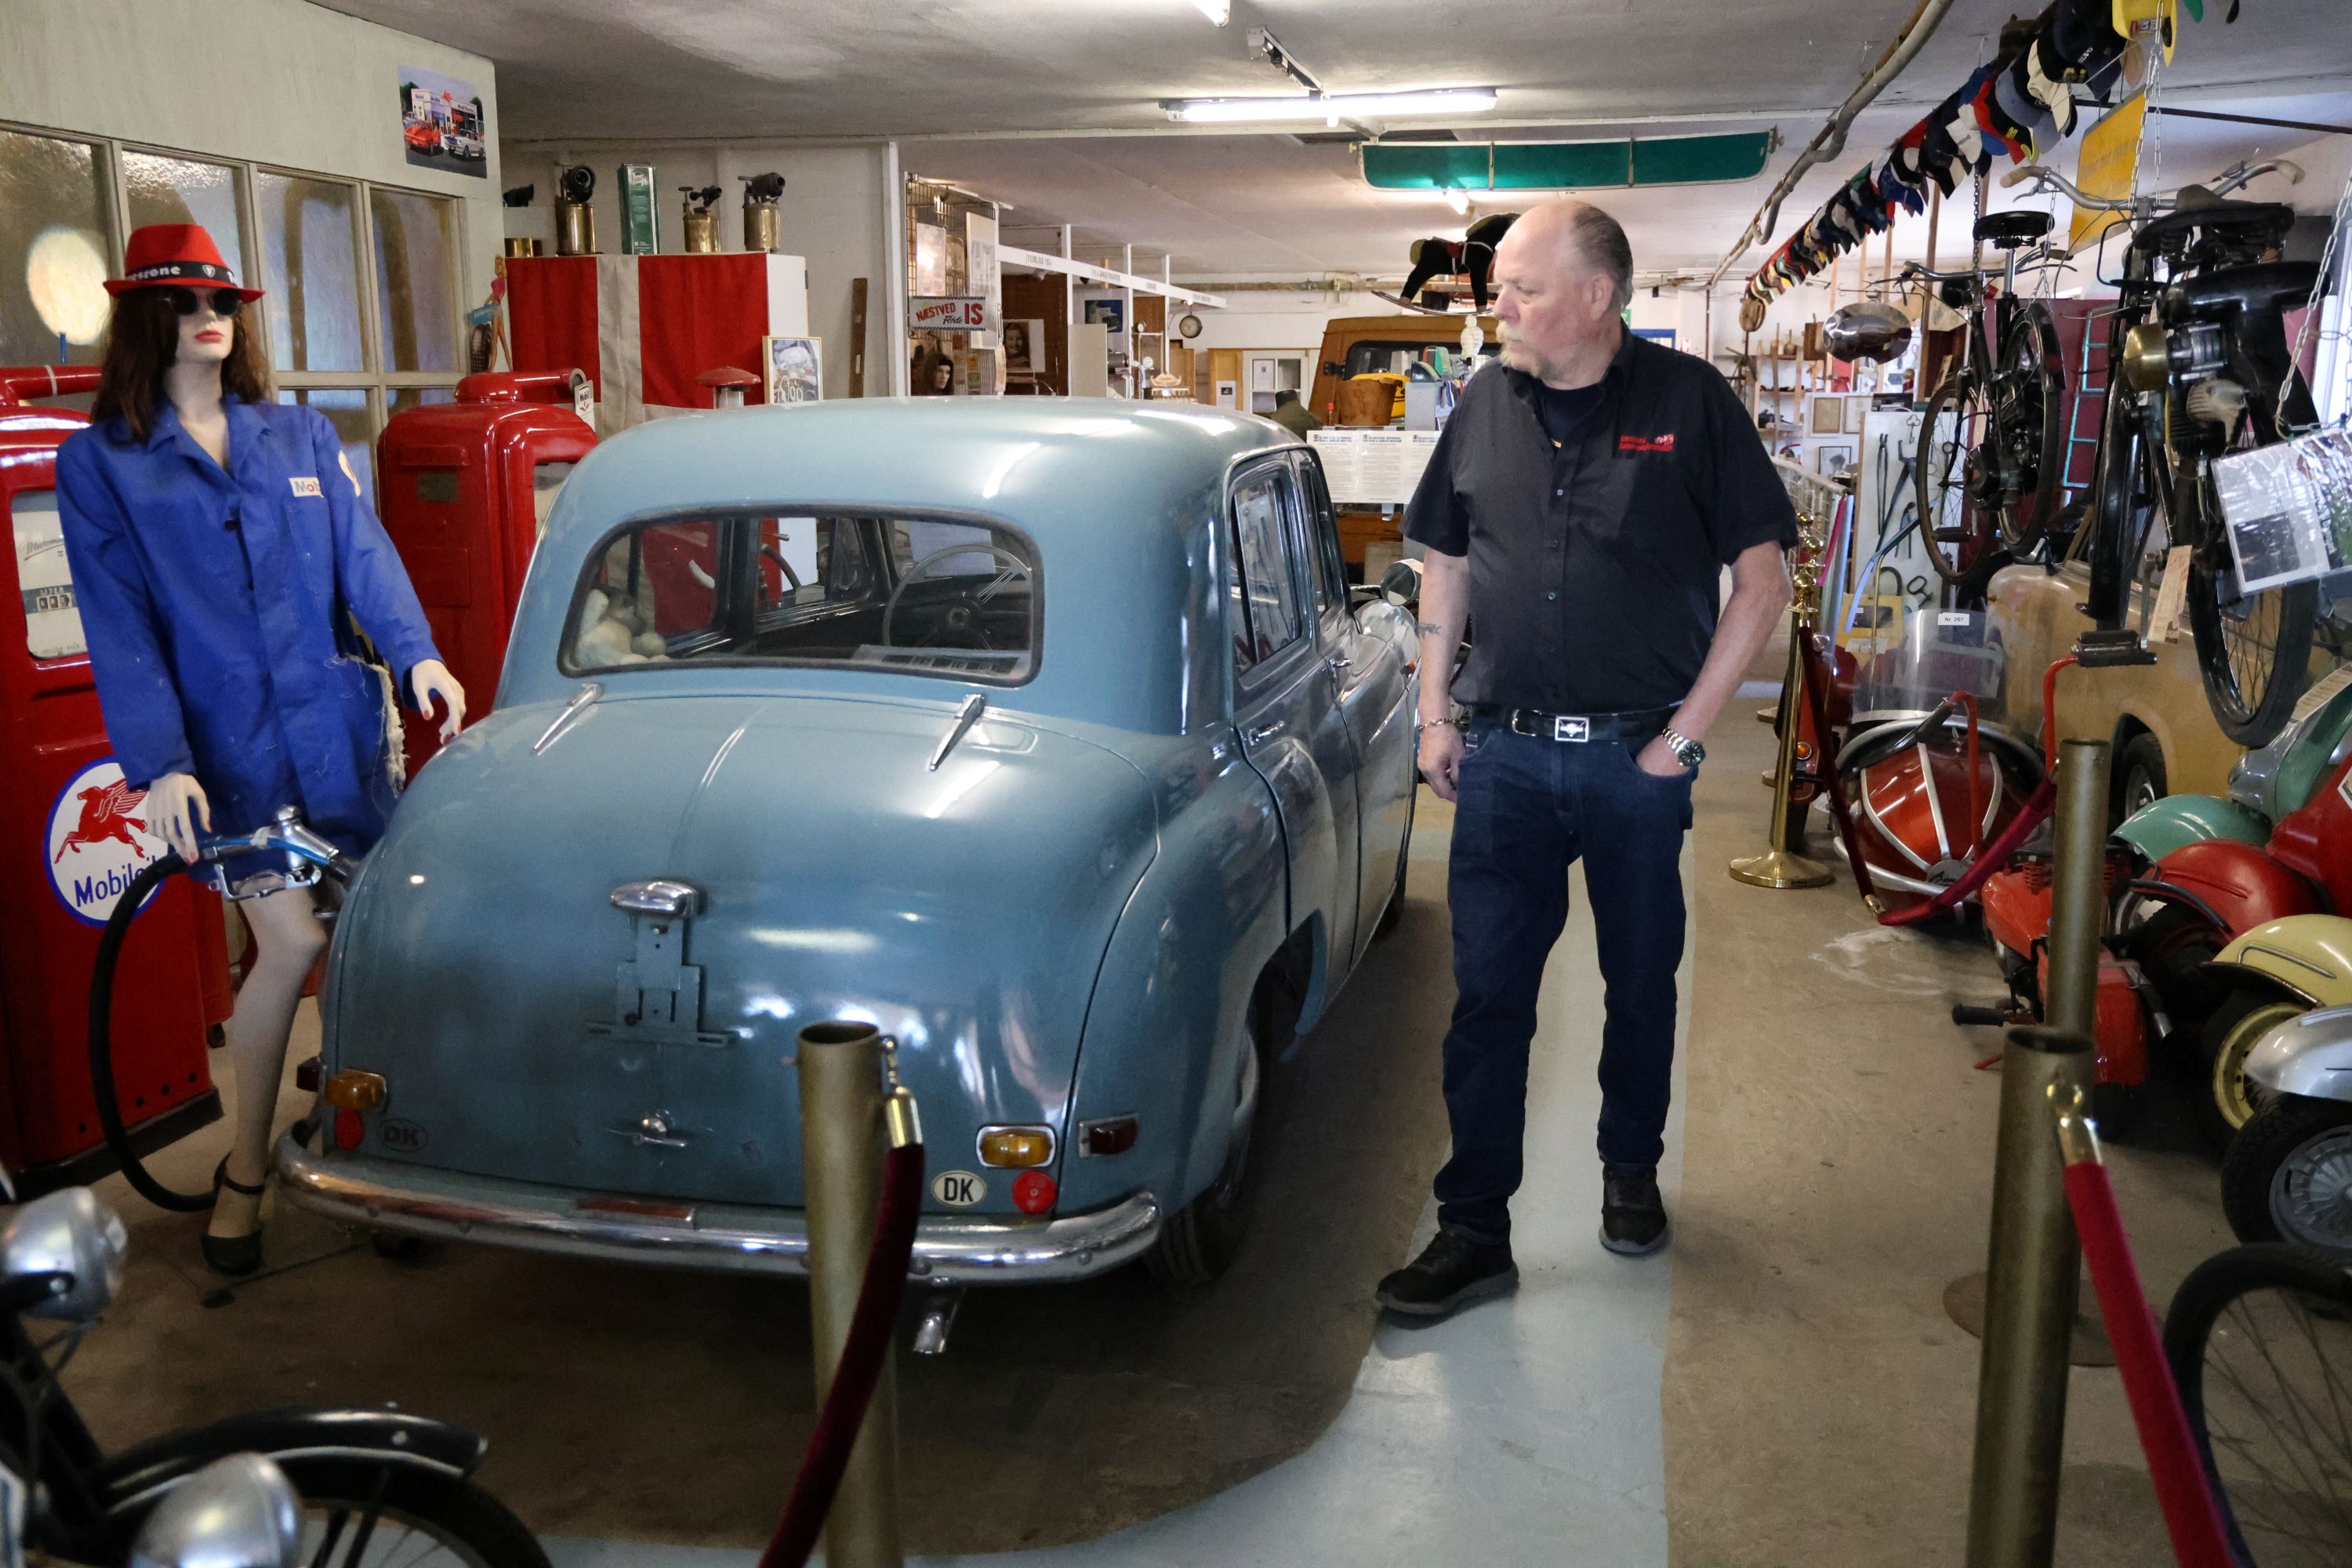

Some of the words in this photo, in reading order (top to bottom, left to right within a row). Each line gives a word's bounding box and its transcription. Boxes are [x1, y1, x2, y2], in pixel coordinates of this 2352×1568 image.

[916, 303, 956, 321] NÆSTVED
[964, 303, 983, 325] IS
[74, 855, 157, 907] Mobil
[384, 1125, 419, 1146] DK
[944, 1177, 974, 1203] DK
